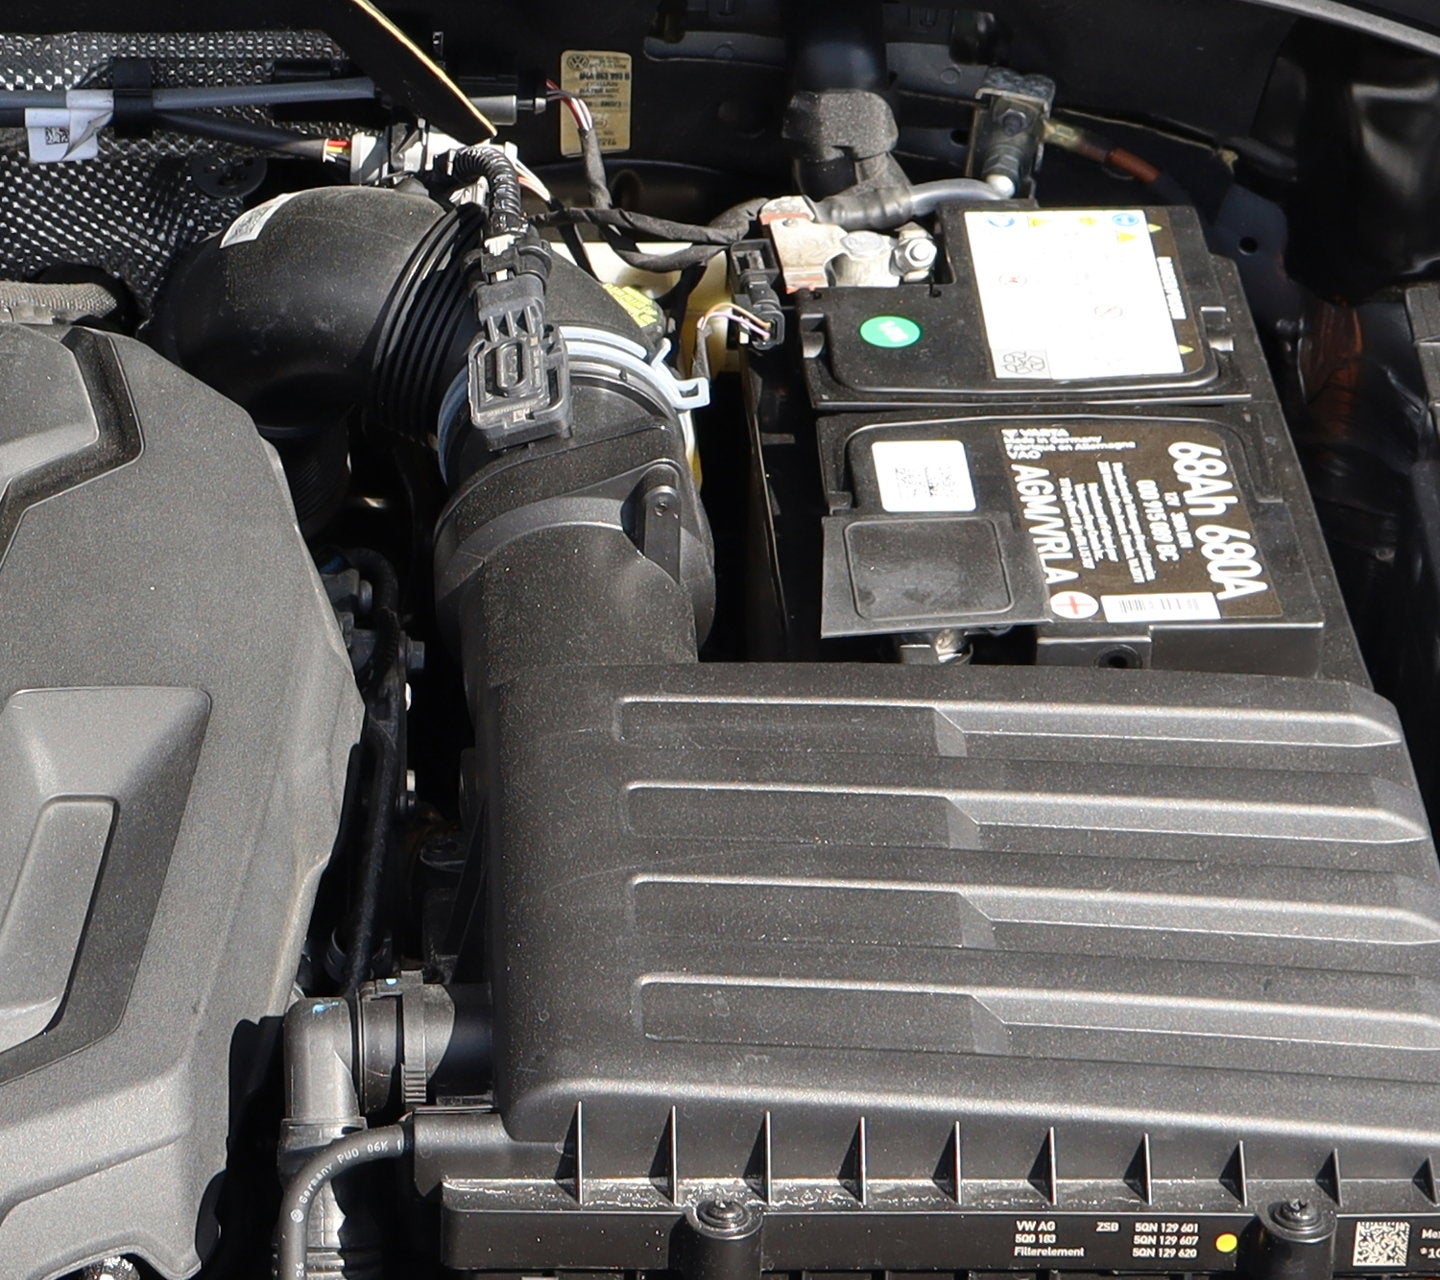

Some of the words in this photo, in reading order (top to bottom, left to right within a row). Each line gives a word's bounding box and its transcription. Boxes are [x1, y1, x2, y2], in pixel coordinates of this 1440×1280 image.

[1168, 442, 1238, 516] 68Ah
[1195, 525, 1268, 600] 680A
[299, 1163, 333, 1204] Germany
[1016, 1221, 1036, 1231] VW
[1038, 1221, 1055, 1231] AG
[1161, 1223, 1178, 1233] 129
[1160, 1235, 1177, 1245] 129
[1179, 1236, 1199, 1246] 607
[1158, 1248, 1176, 1257] 129
